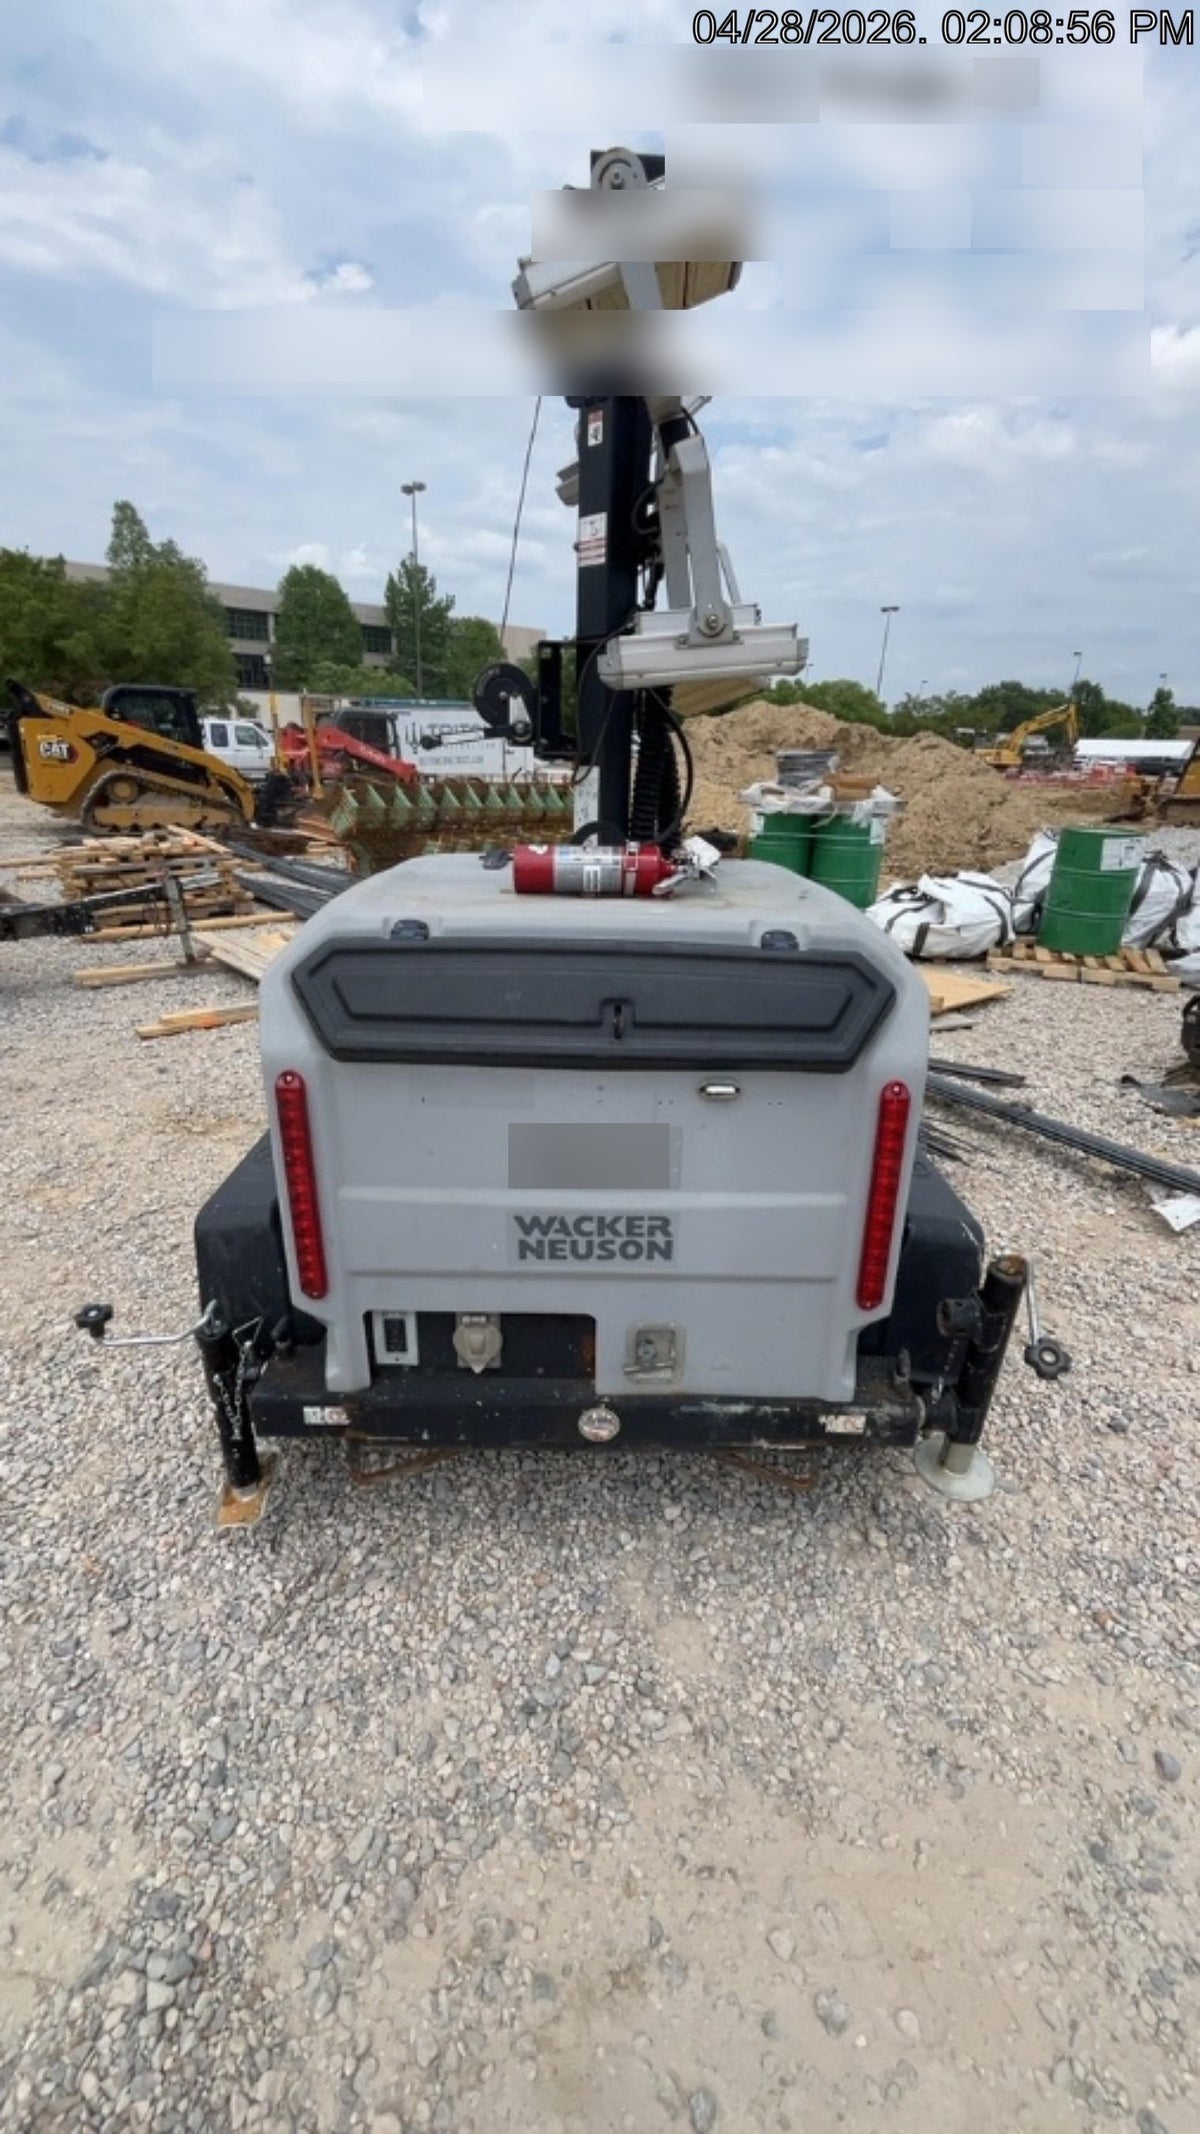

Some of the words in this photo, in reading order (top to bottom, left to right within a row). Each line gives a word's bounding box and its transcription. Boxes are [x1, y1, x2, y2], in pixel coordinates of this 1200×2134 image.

[40, 741, 69, 759] CAT
[513, 1215, 673, 1238] WACKER
[517, 1239, 674, 1261] NEUSON
